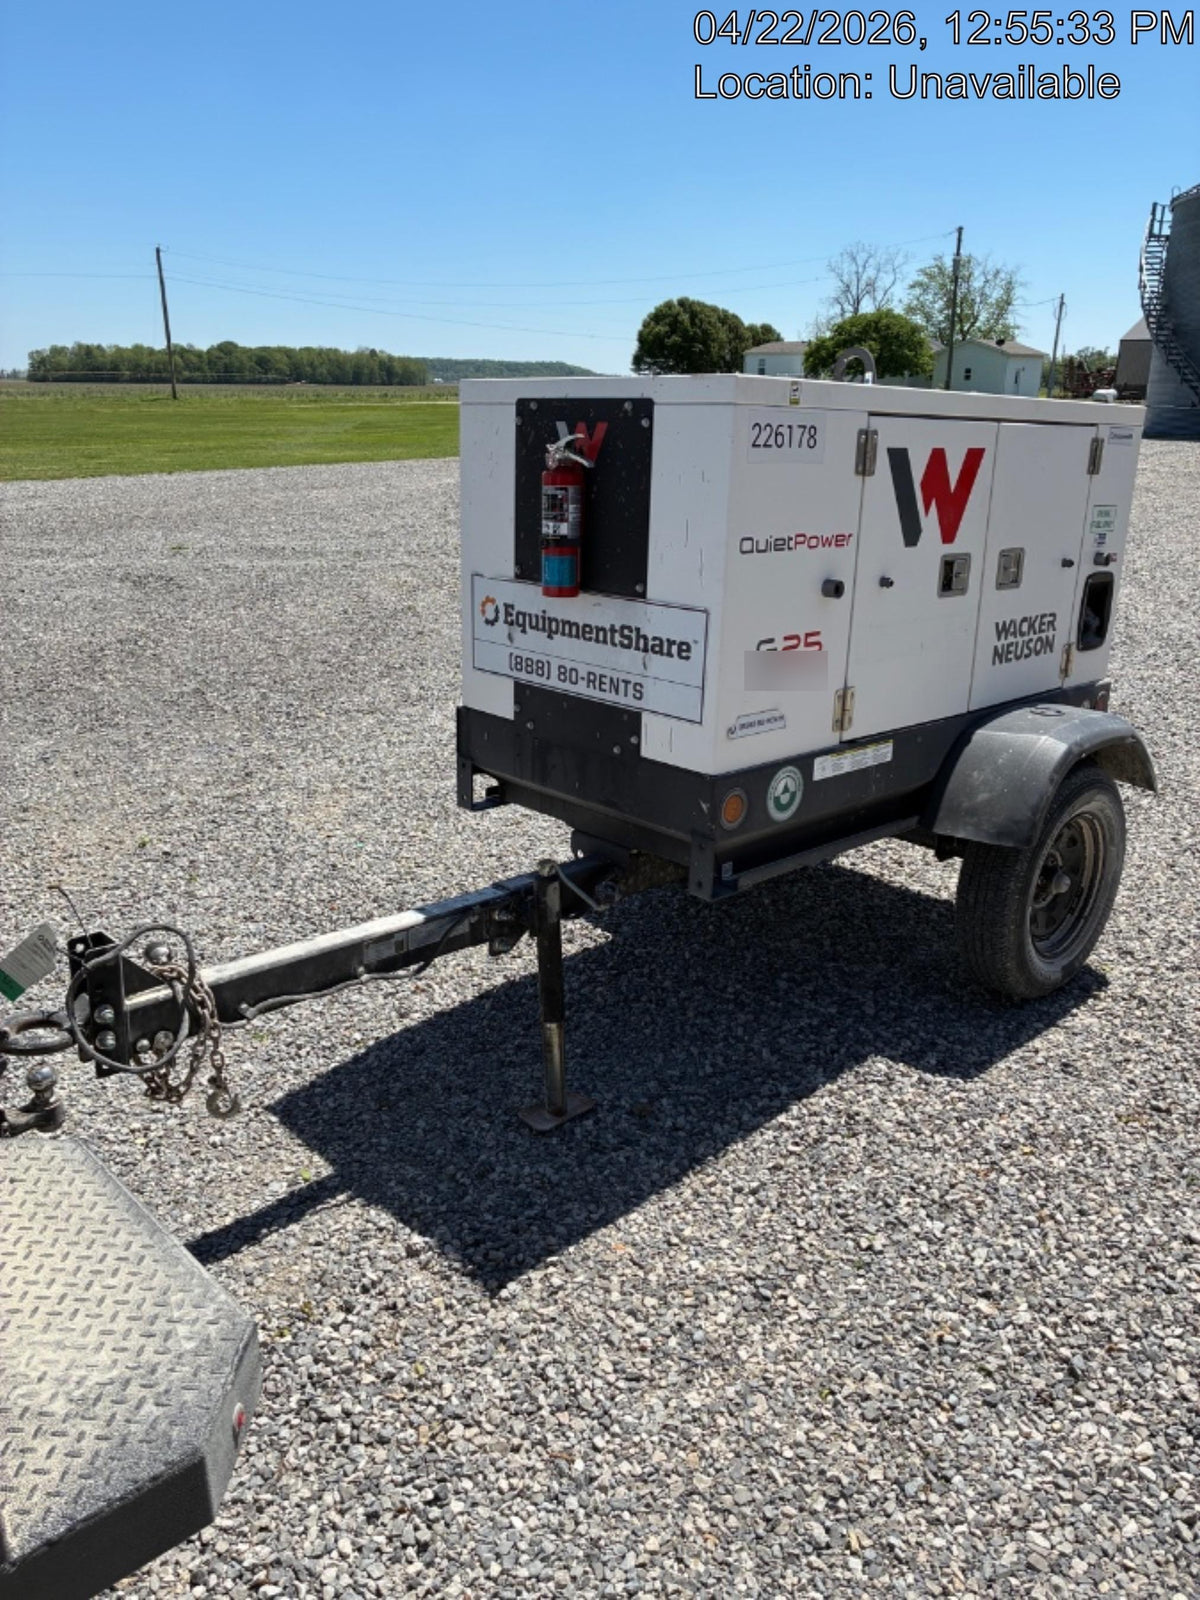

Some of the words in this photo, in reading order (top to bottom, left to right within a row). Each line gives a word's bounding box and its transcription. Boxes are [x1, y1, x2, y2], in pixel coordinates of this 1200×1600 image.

[751, 422, 817, 449] 226178
[739, 532, 853, 555] QuietPower
[995, 612, 1057, 642] WACKER
[992, 633, 1056, 666] NEUSON
[508, 652, 551, 680] (888)
[557, 665, 645, 701] 80-RENTS
